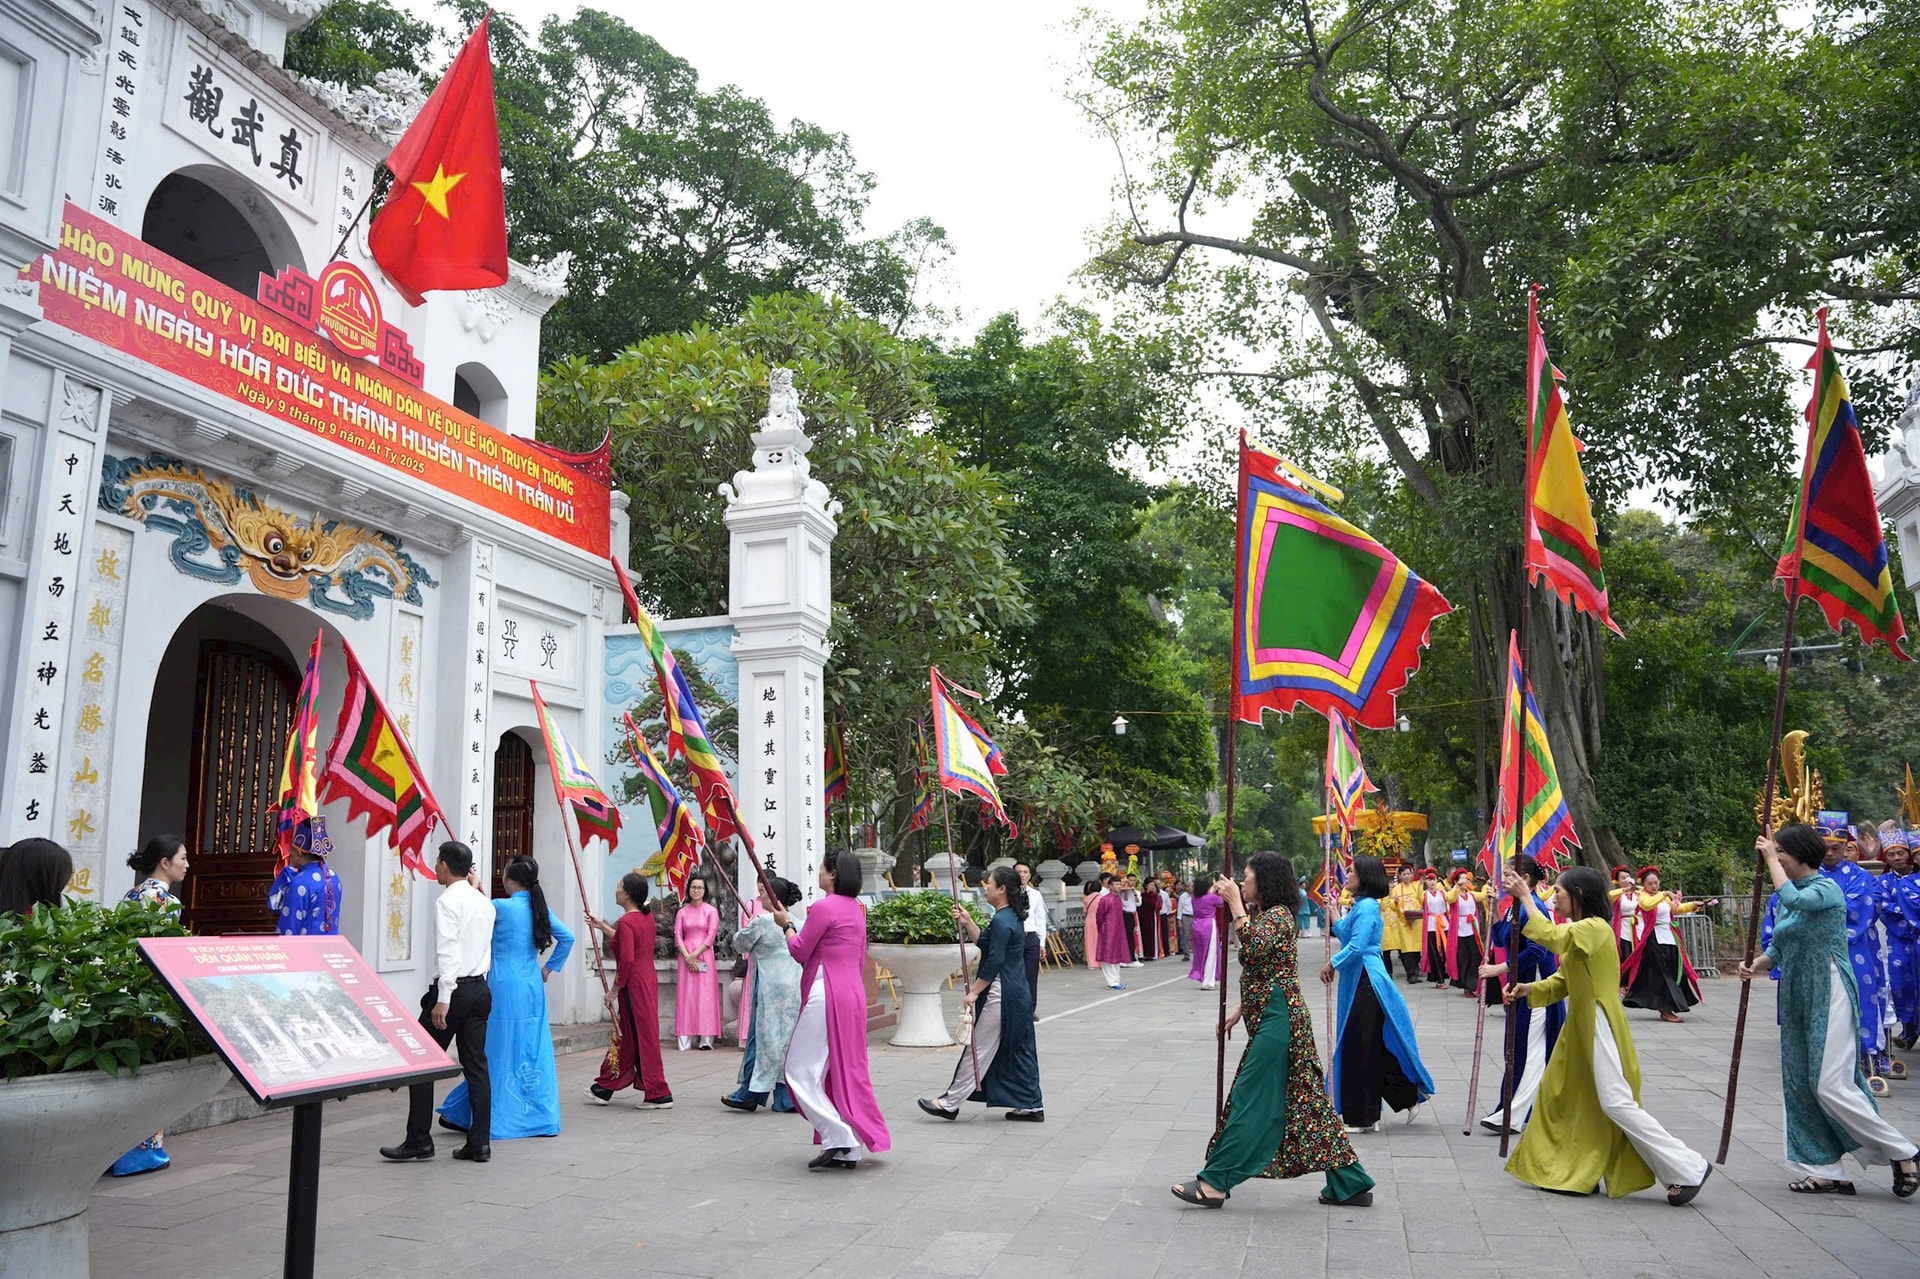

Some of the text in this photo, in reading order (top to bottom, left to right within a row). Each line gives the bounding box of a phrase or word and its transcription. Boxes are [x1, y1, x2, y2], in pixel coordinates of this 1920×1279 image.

[42, 253, 127, 319] NIỆM
[135, 297, 215, 358] NGÀY
[220, 338, 272, 385] HÓA
[276, 366, 325, 409] ĐỨC
[328, 390, 398, 443] THÁNH
[401, 425, 464, 474] HUYỀN
[466, 456, 514, 497] THIÊN
[516, 479, 554, 516] TRẤN
[192, 290, 234, 326] QUÝ
[239, 312, 257, 344] VỊ
[262, 325, 290, 358] ĐẠI
[294, 341, 327, 374] BIỂU
[331, 359, 351, 387] VÀ
[355, 372, 393, 407] NHÂN
[396, 391, 423, 423] DÂN
[426, 408, 442, 432] VỀ
[463, 425, 476, 449] LỄ
[479, 436, 498, 461] HỘI
[543, 466, 574, 497] THỐNG
[349, 329, 359, 343] BA
[237, 383, 274, 409] Ngày
[277, 400, 286, 413] 9
[289, 406, 326, 433] tháng
[328, 421, 337, 435] 9
[339, 430, 365, 448] năm
[399, 454, 425, 474] 2025
